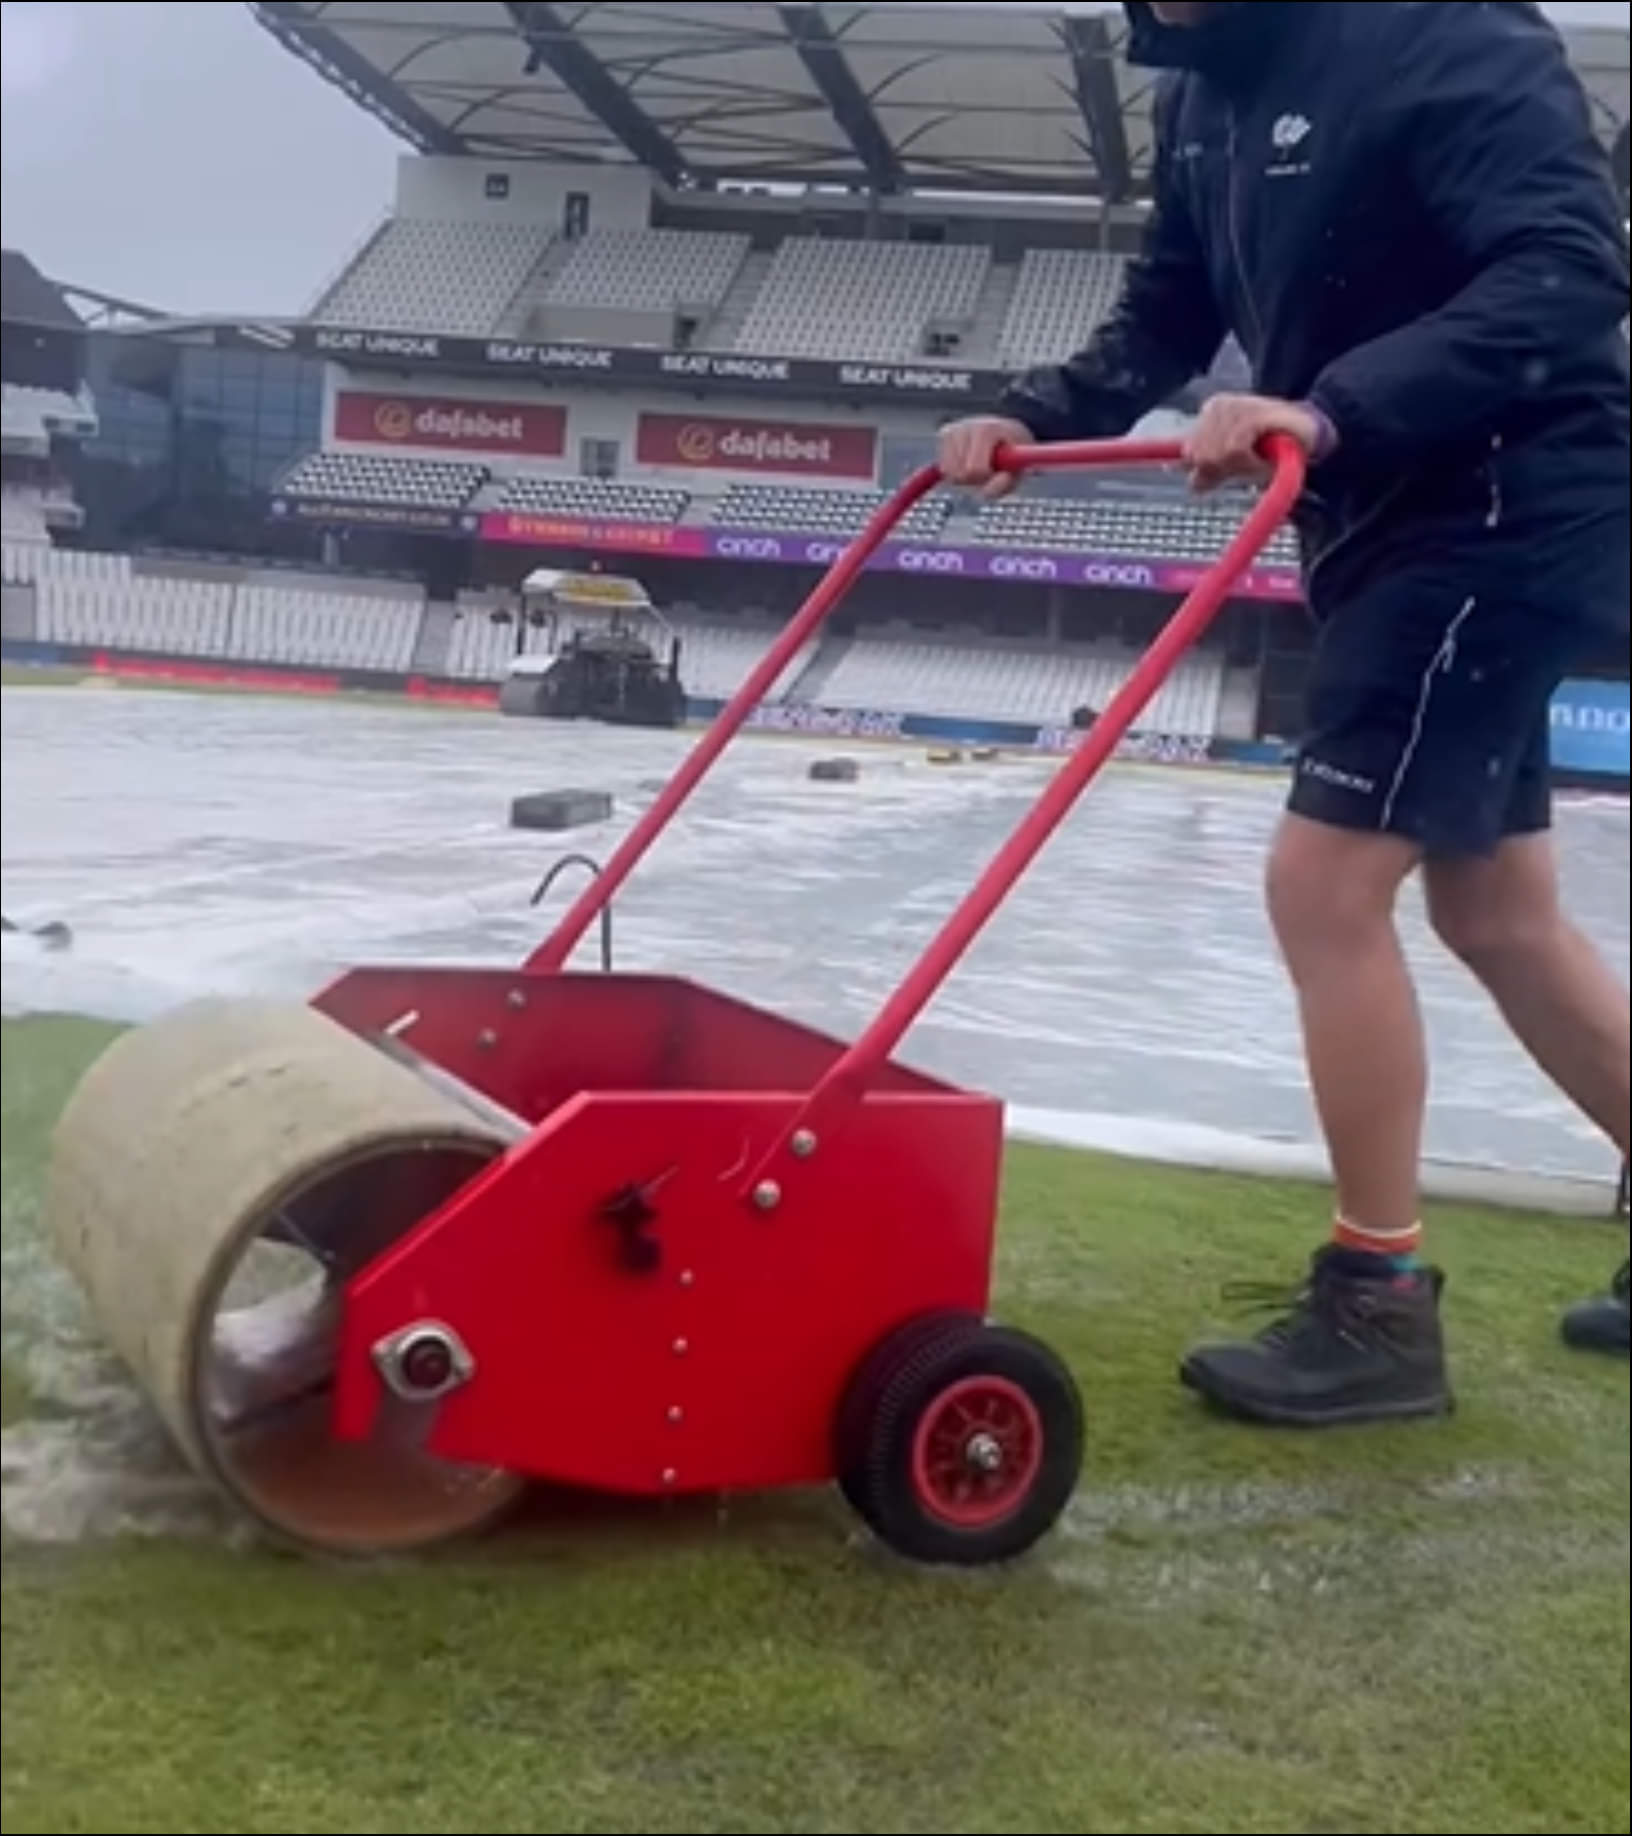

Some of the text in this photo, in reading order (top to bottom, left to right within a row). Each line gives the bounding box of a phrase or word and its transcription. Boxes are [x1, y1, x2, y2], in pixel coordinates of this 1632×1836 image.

[416, 408, 523, 439] dafabet
[720, 428, 830, 462] dafabet
[717, 536, 781, 557] cinch
[898, 551, 963, 571] cinch
[989, 556, 1057, 577] cinch
[1085, 564, 1152, 585] cinch
